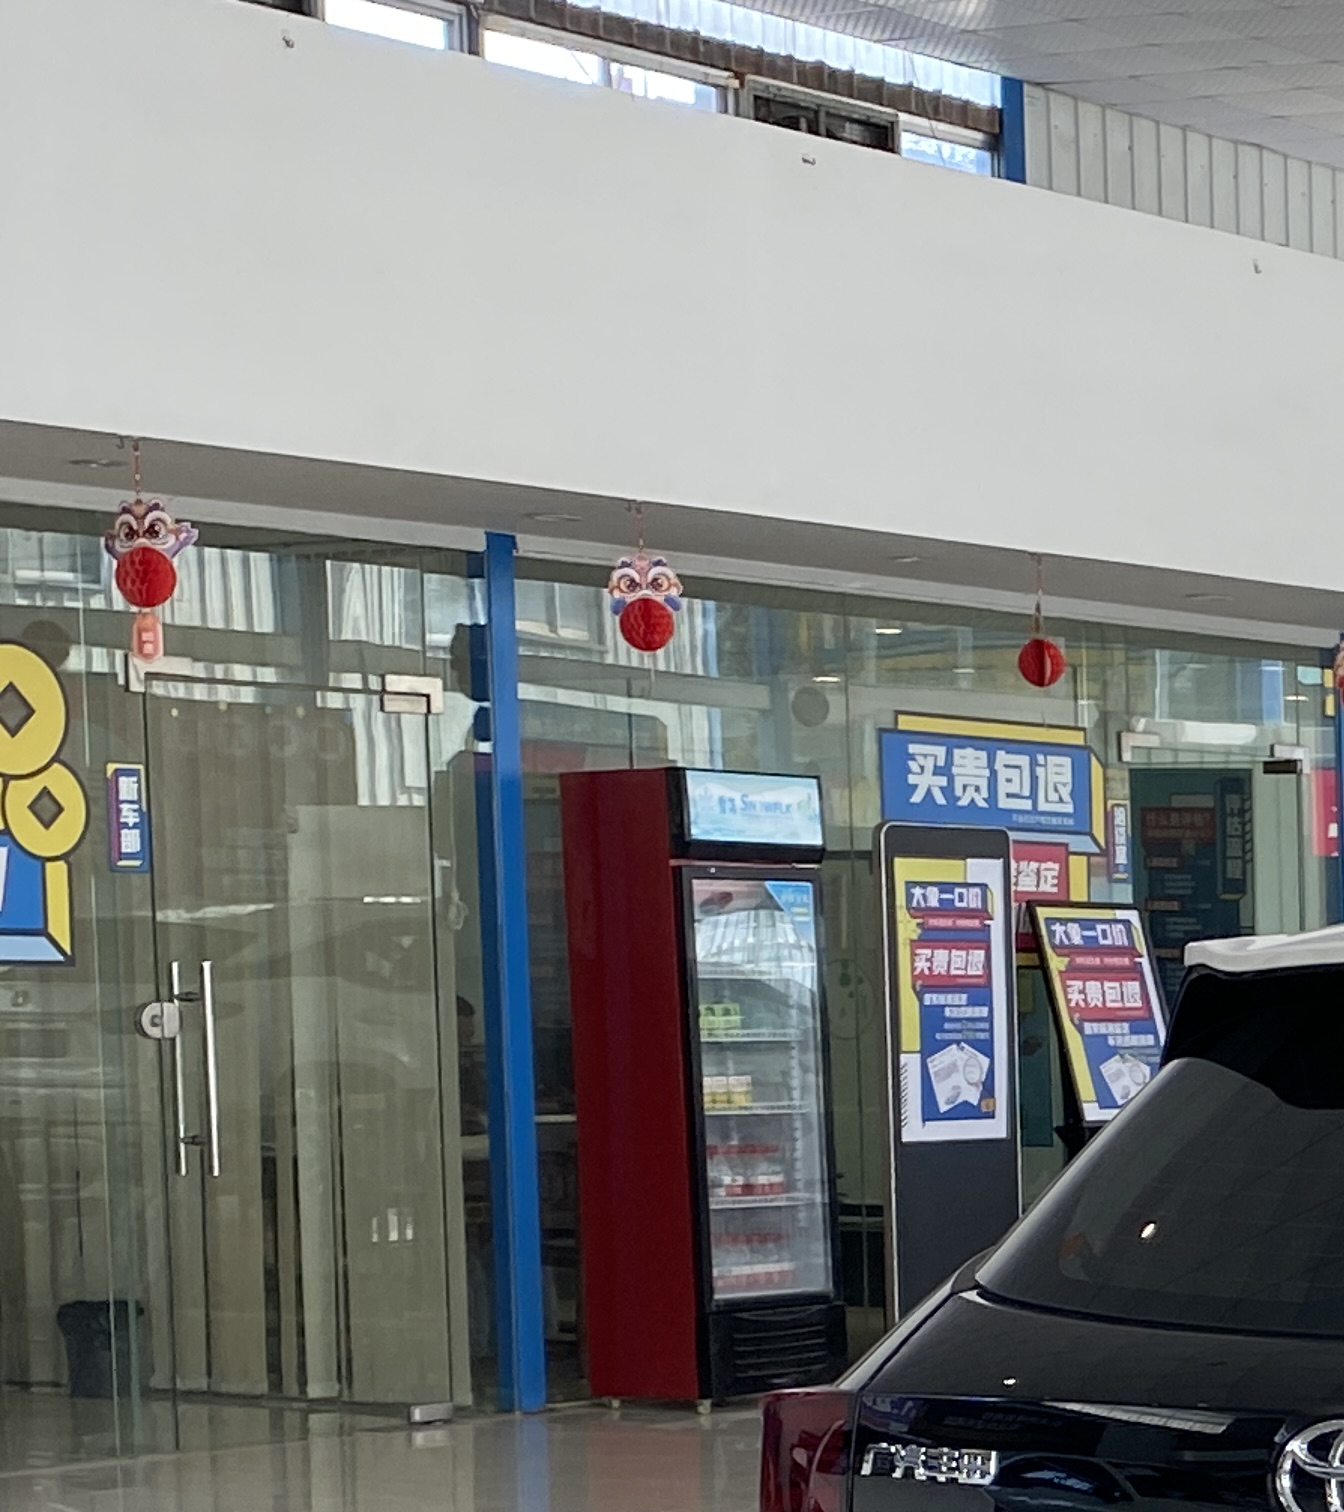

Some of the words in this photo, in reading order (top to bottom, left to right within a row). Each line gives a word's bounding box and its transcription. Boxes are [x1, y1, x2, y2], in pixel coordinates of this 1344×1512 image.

[907, 743, 1075, 813] 买贵包退
[1012, 860, 1060, 893] 鉴定
[913, 949, 985, 976] 买贵包退
[1066, 980, 1143, 1008] 买贵包退
